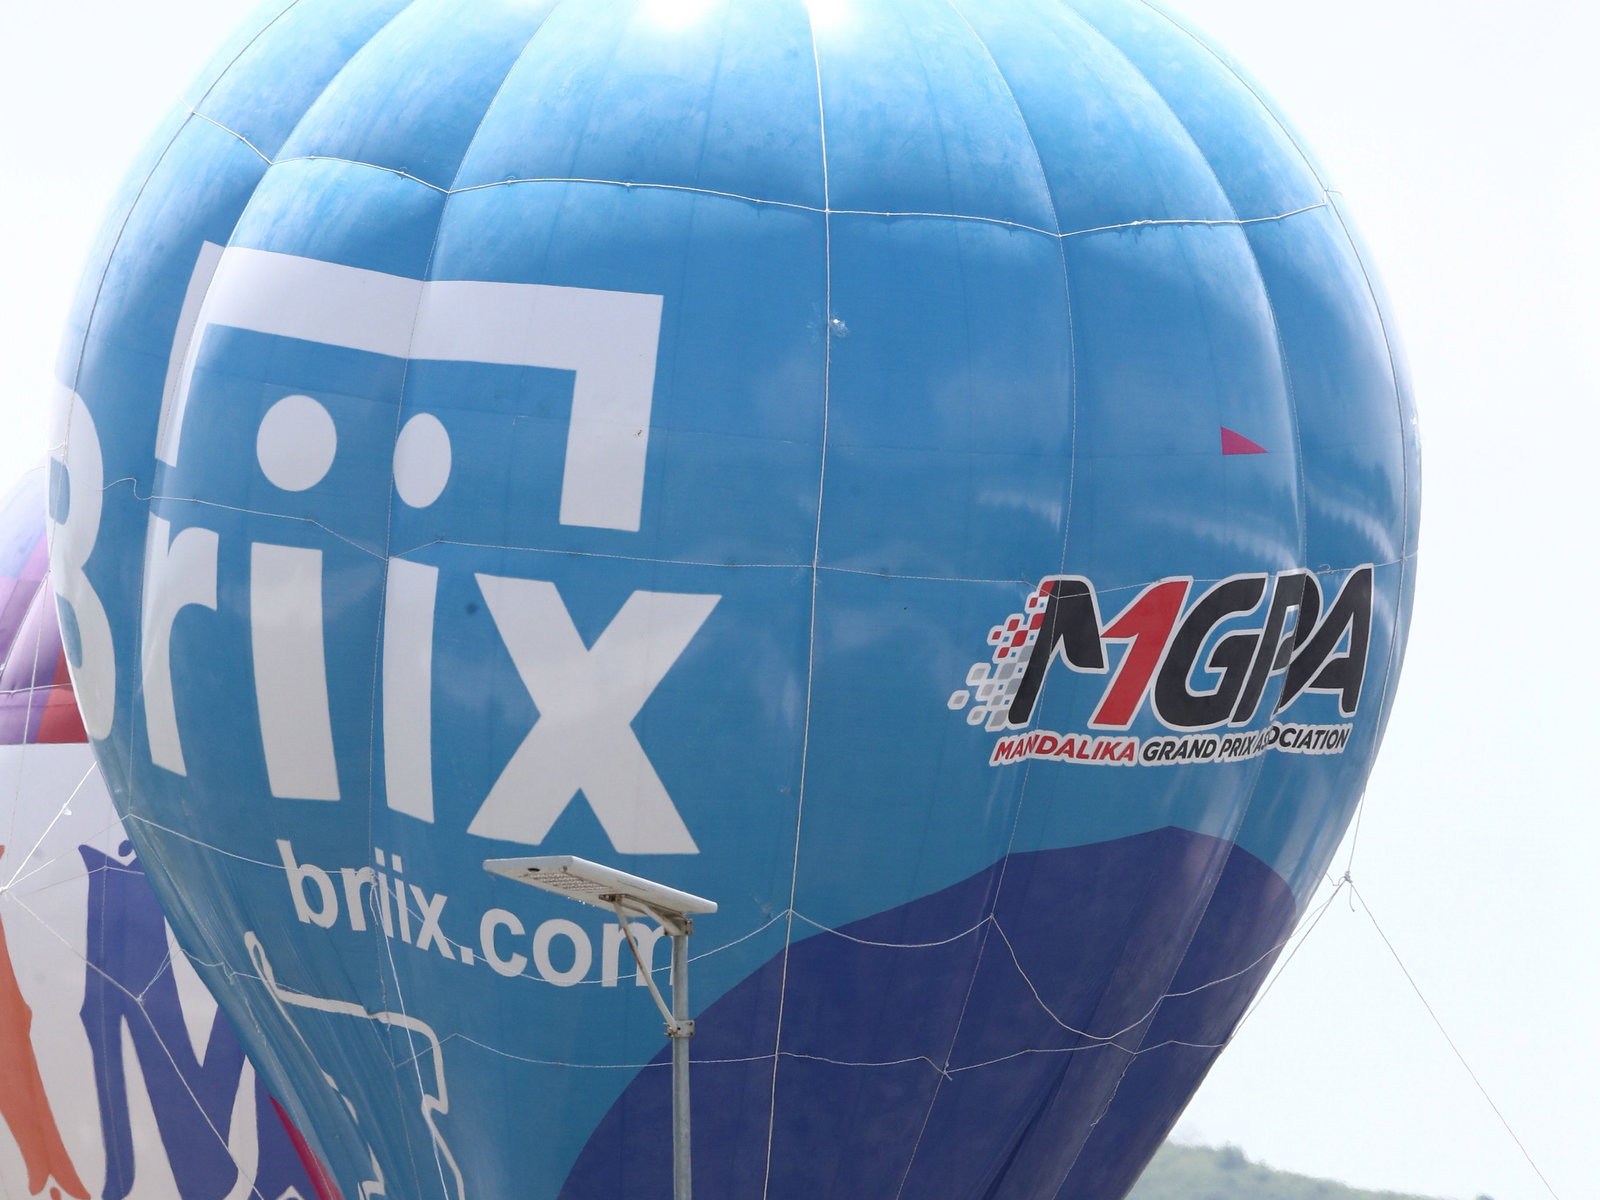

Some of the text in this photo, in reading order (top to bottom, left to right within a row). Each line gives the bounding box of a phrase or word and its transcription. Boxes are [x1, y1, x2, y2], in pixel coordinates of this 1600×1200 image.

[46, 379, 722, 856] Briix
[993, 733, 1136, 762] MANDALIKA
[1142, 738, 1218, 761] GRAND
[1218, 735, 1256, 758] PRIX
[276, 838, 674, 988] briix.com
